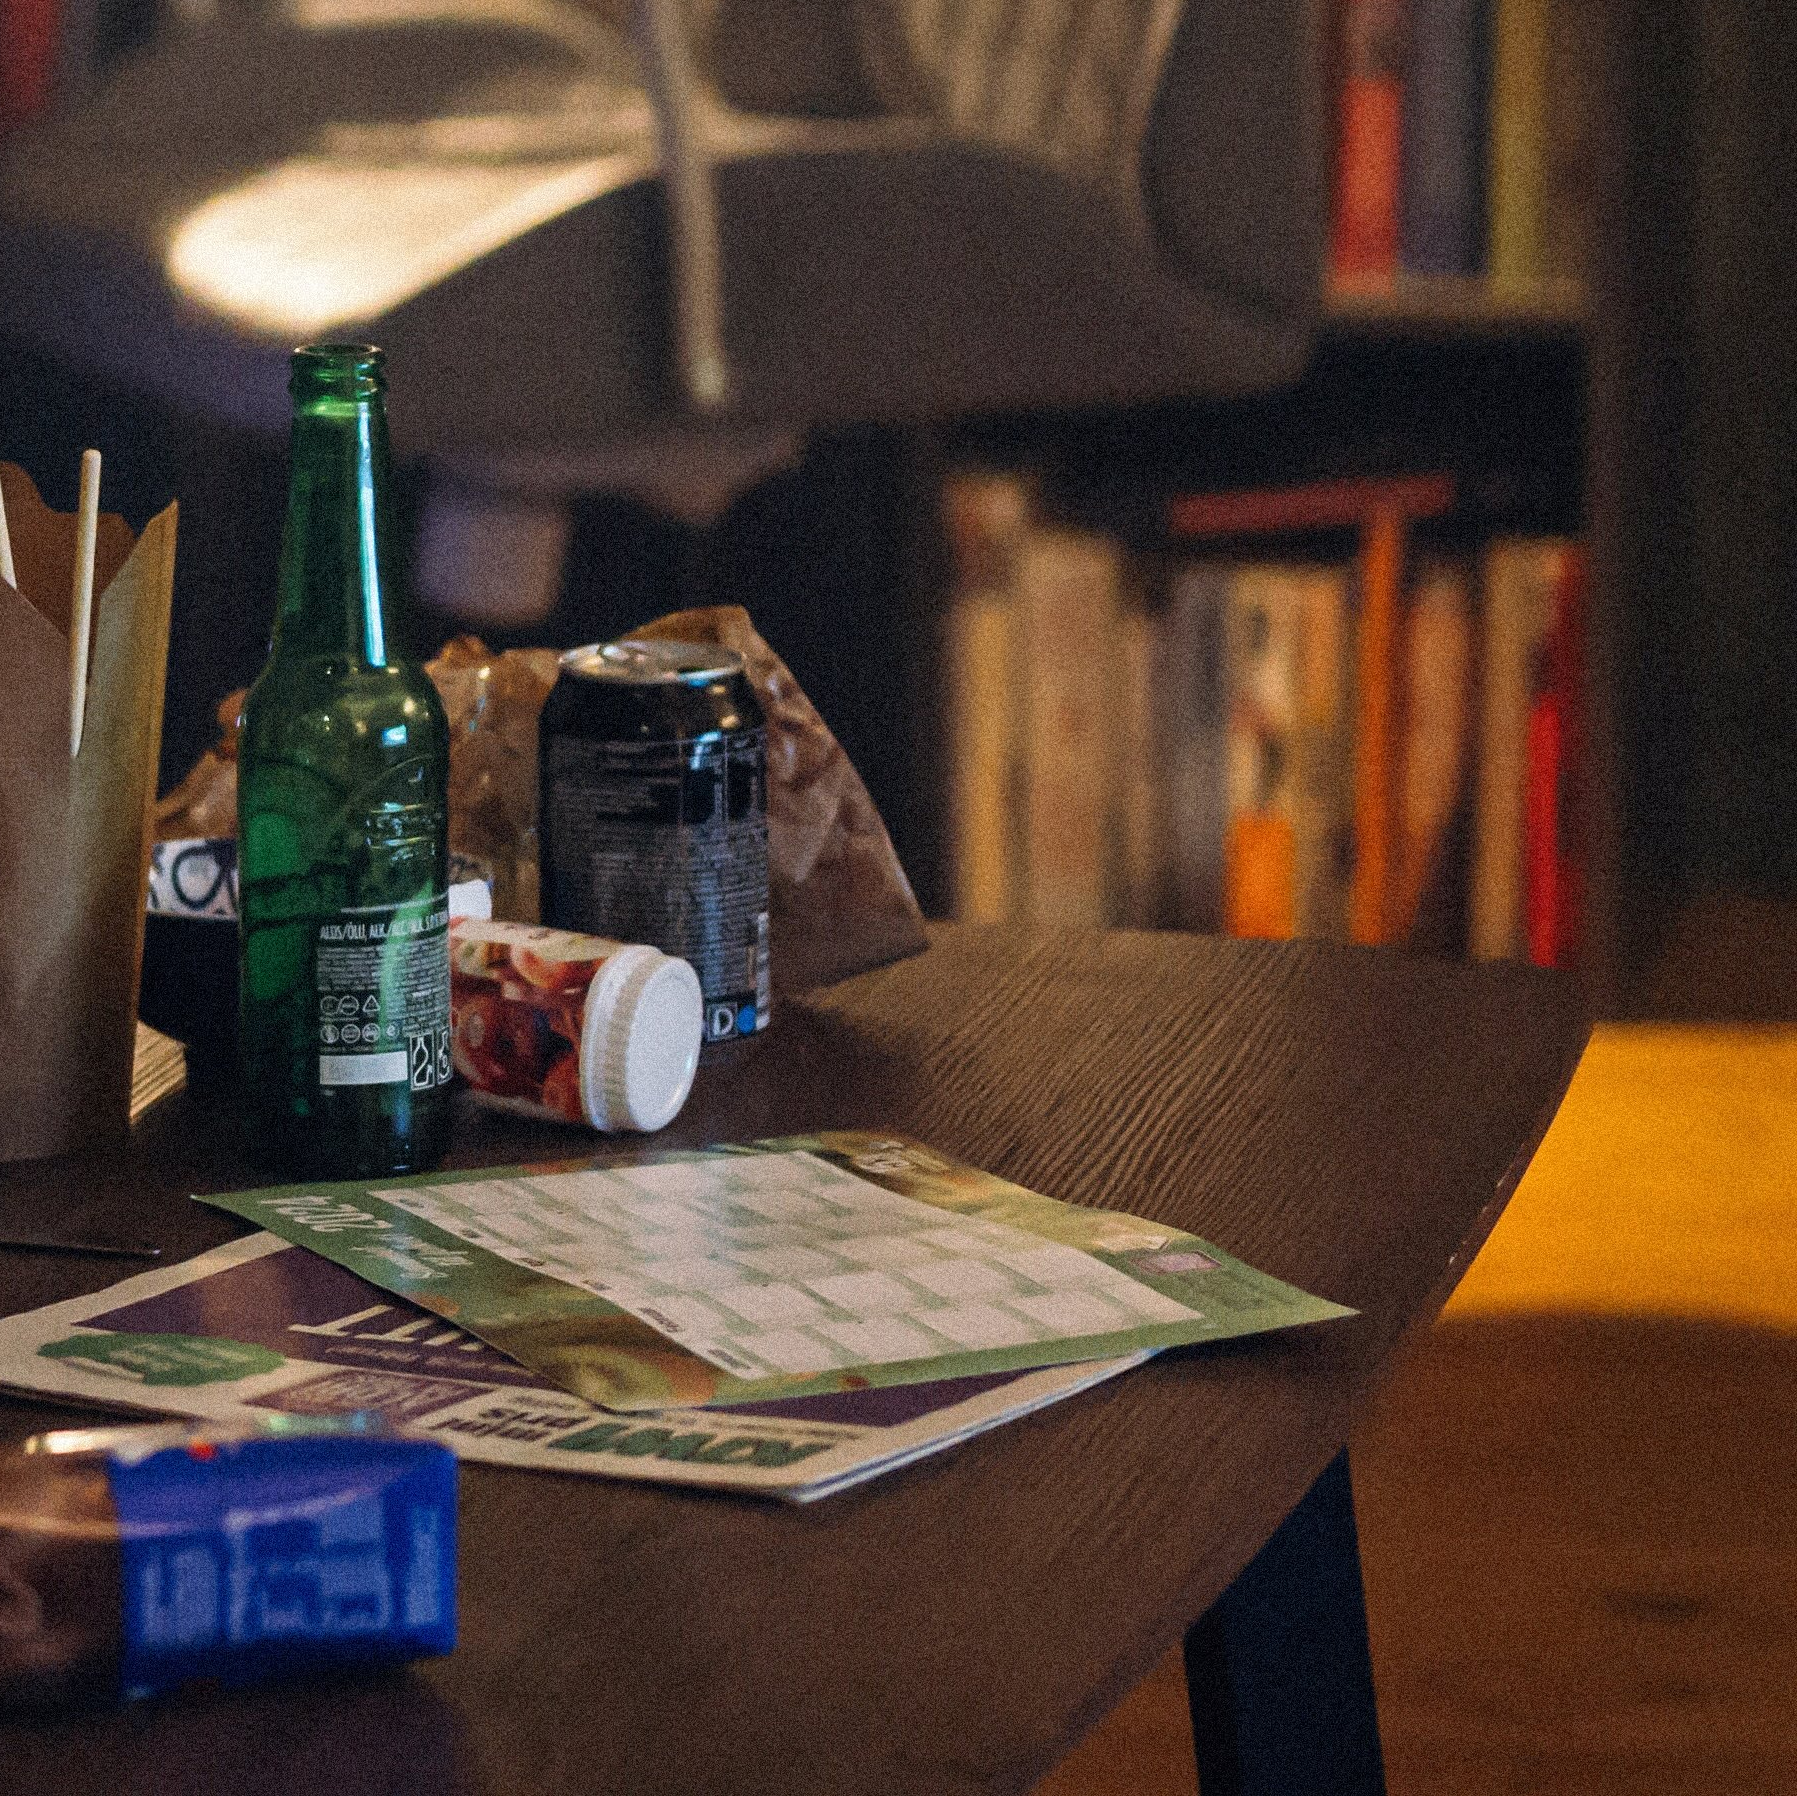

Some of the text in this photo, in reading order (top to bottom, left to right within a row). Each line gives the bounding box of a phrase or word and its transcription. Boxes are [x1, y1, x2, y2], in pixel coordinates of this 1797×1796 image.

[426, 1416, 552, 1442] mini
[479, 1406, 592, 1430] pris
[546, 1421, 835, 1467] KIWI
